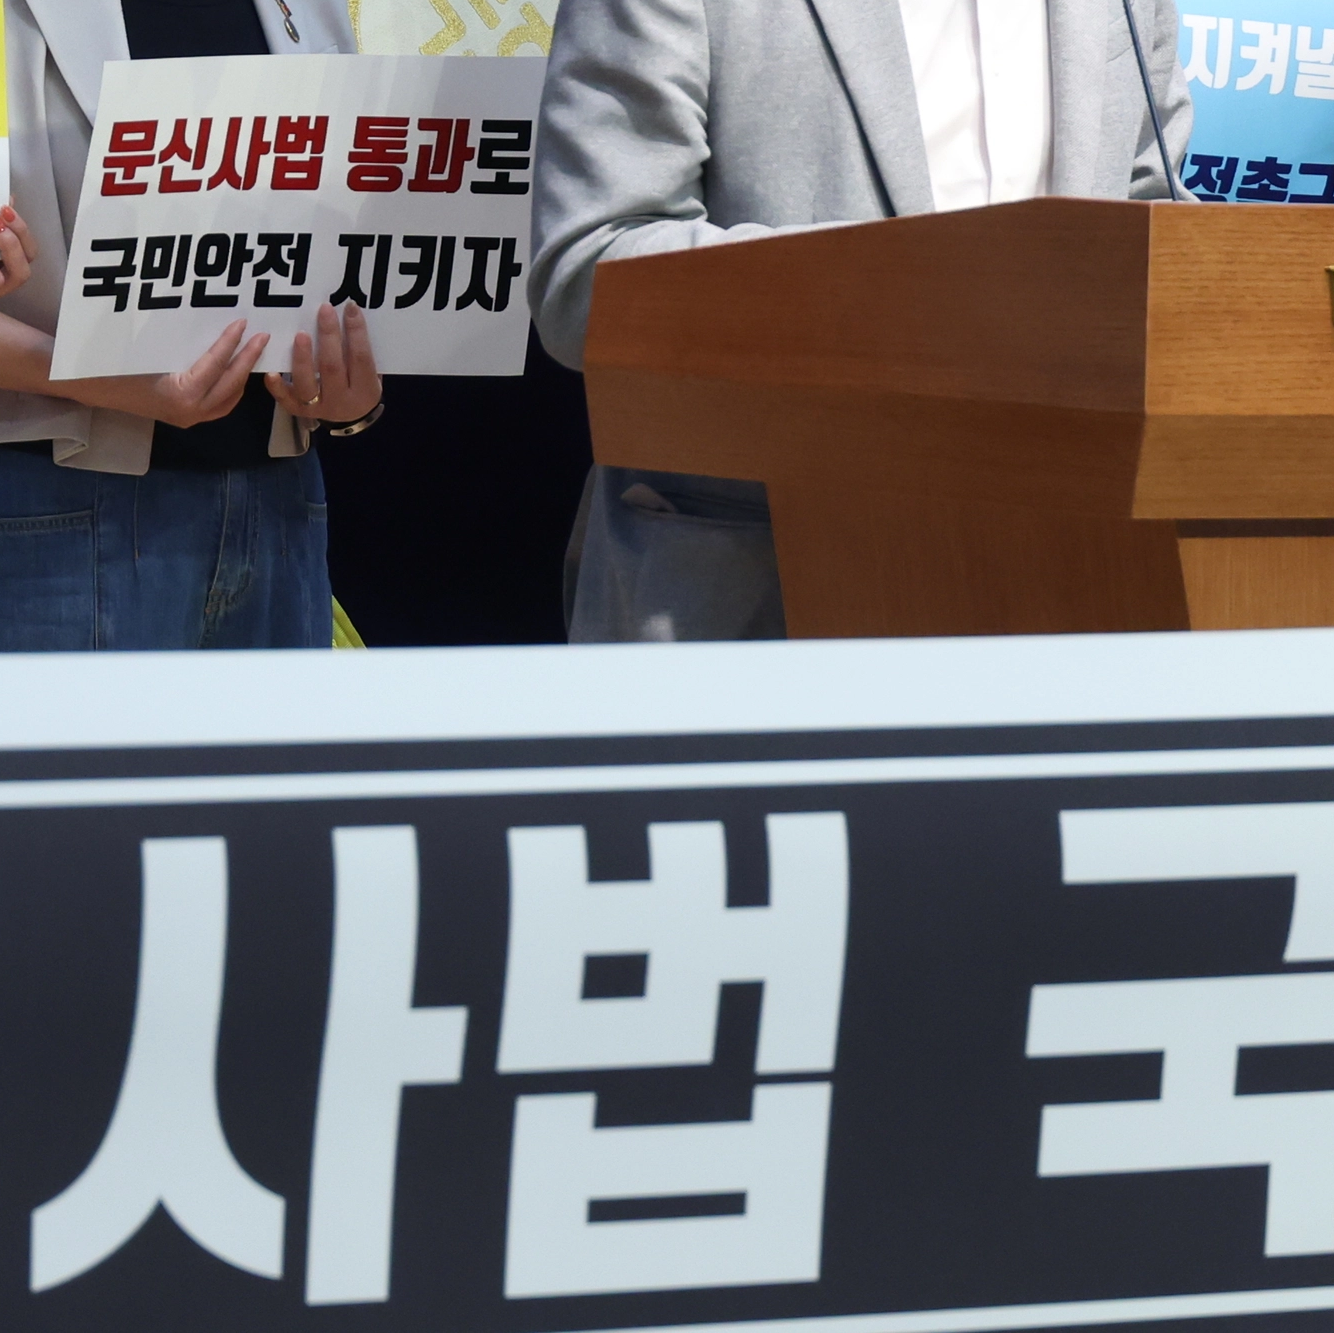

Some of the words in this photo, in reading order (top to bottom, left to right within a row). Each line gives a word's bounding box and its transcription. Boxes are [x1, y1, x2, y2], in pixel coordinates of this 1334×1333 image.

[100, 115, 330, 196] 문신사법
[346, 116, 534, 195] 통과로
[82, 233, 313, 312] 국민안전
[329, 234, 522, 312] 지키자
